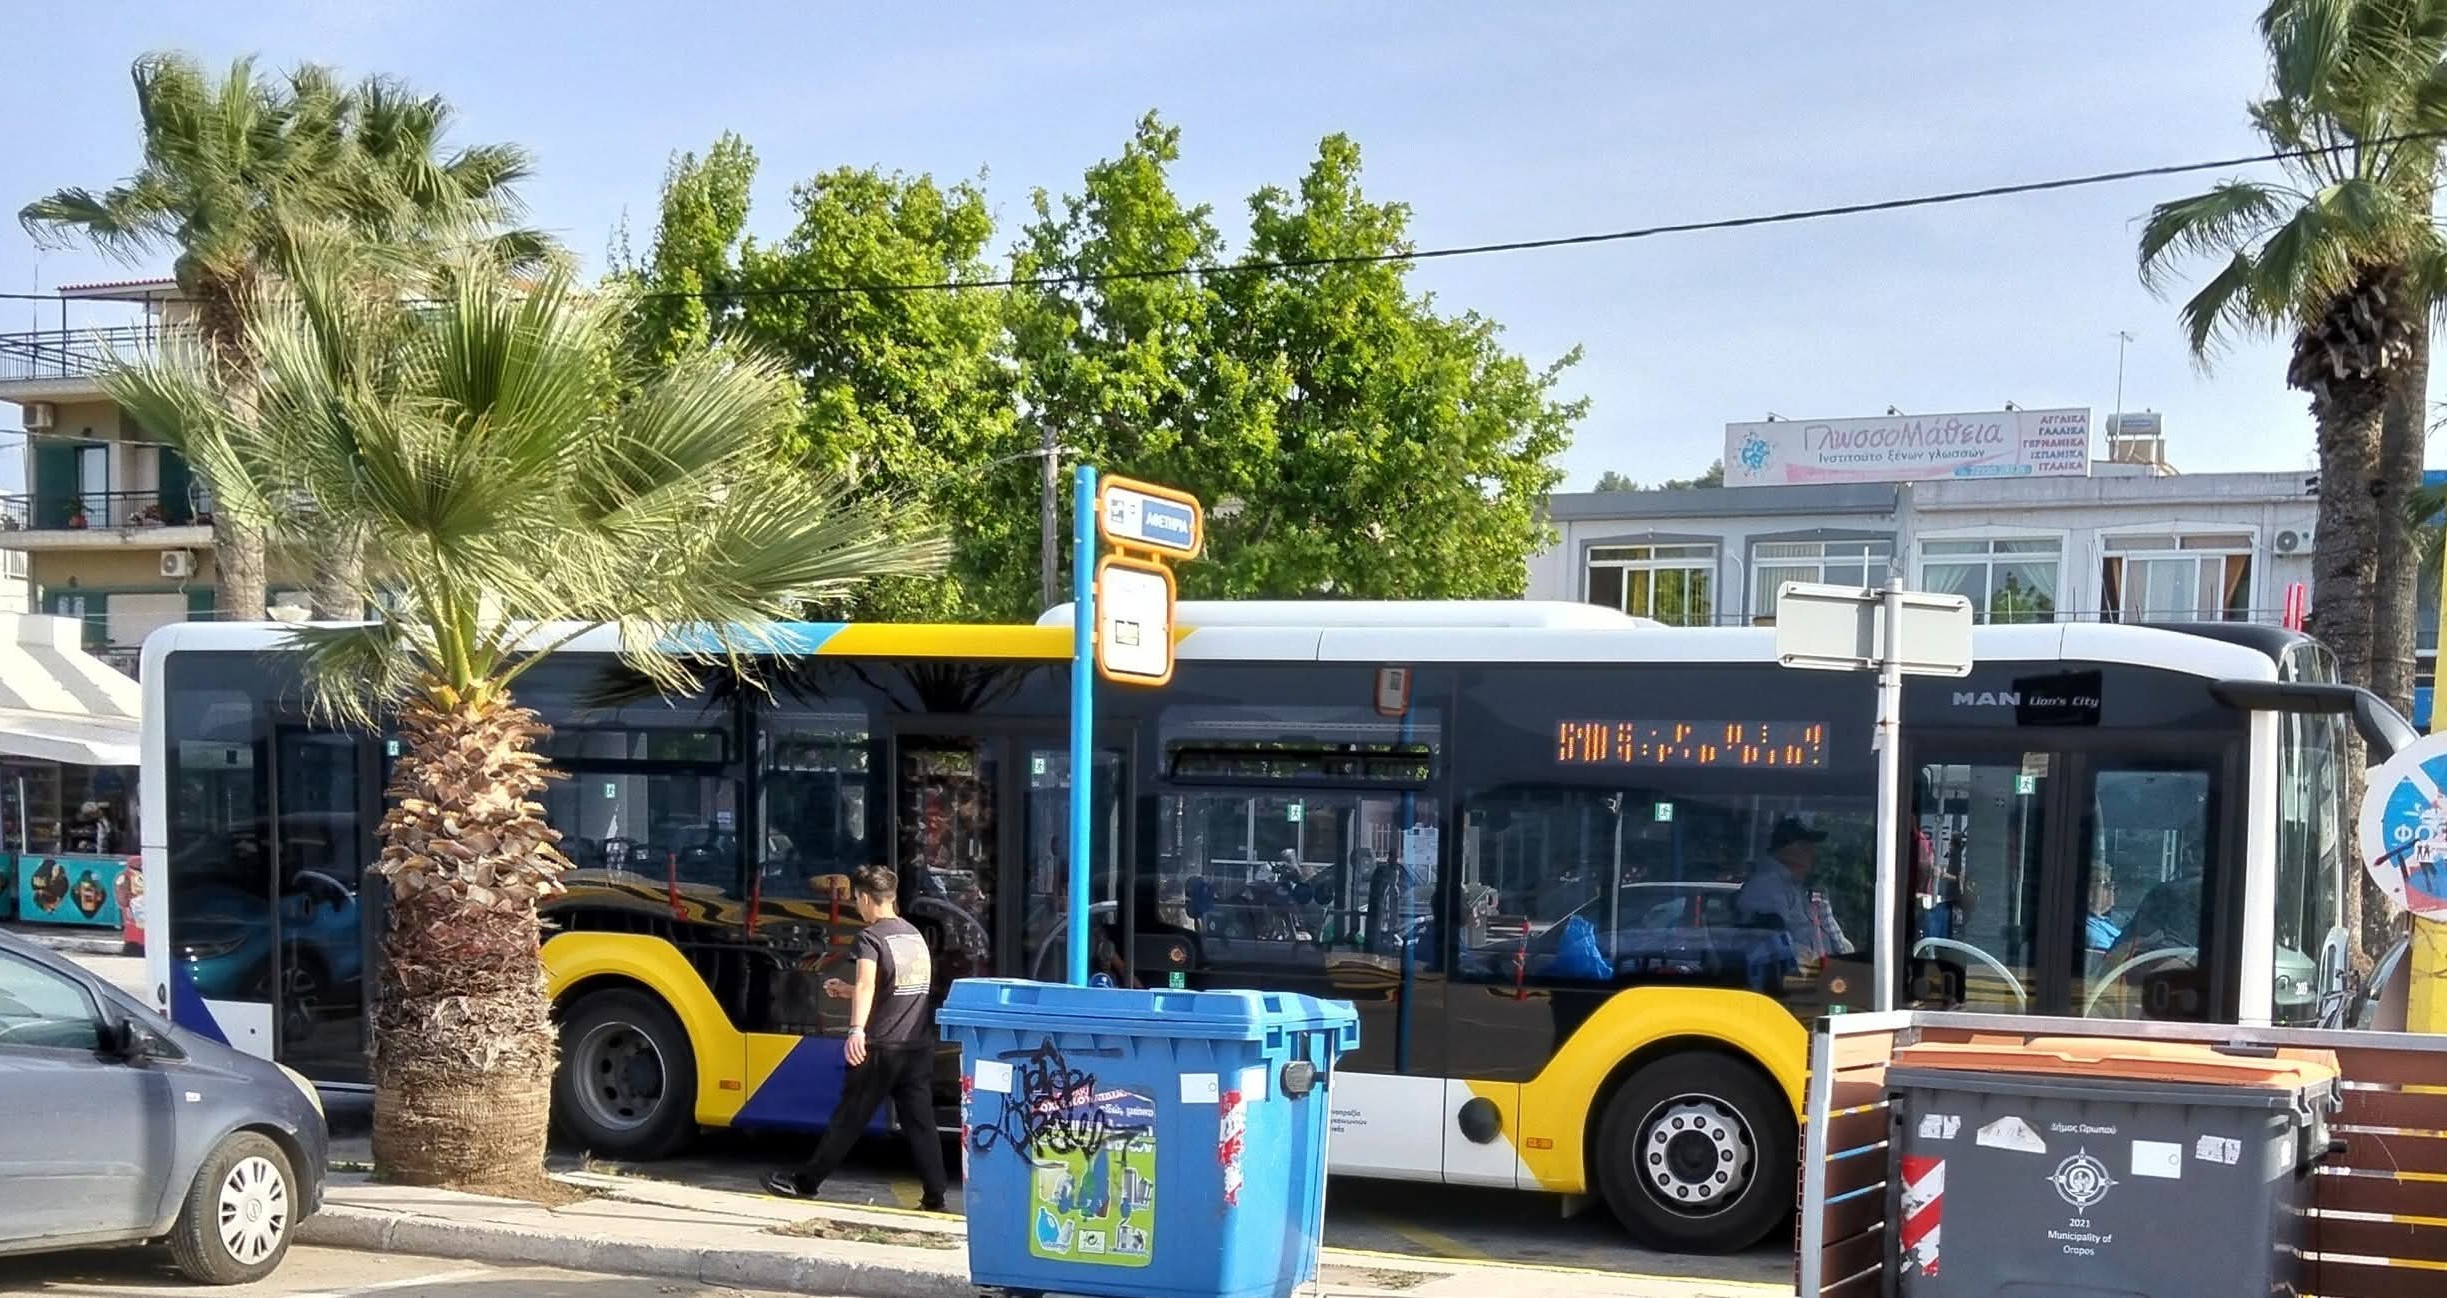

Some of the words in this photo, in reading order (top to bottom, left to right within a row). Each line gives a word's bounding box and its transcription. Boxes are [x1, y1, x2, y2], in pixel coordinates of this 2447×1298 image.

[2040, 415, 2086, 425] ΑΓΓΛΙΚΑ
[2039, 427, 2085, 436] ΓΑΛΛΙΚΑ
[2023, 439, 2085, 449] ΓΕΡΜΑΝΙΚΑ
[2031, 450, 2084, 460] ΙΣΠΑΝΙΚΑ
[2038, 462, 2083, 471] ΙΤΑΛΙΚΑ
[1952, 692, 2021, 706] MAN
[2029, 696, 2067, 706] Lion's
[2071, 695, 2099, 708] City
[2050, 1121, 2078, 1134] Δήμος
[2079, 1123, 2117, 1136] Ωρωπού
[2069, 1218, 2091, 1228] 2021
[2047, 1229, 2101, 1244] Municipality
[2102, 1233, 2112, 1243] of
[2062, 1244, 2096, 1257] Oropos
